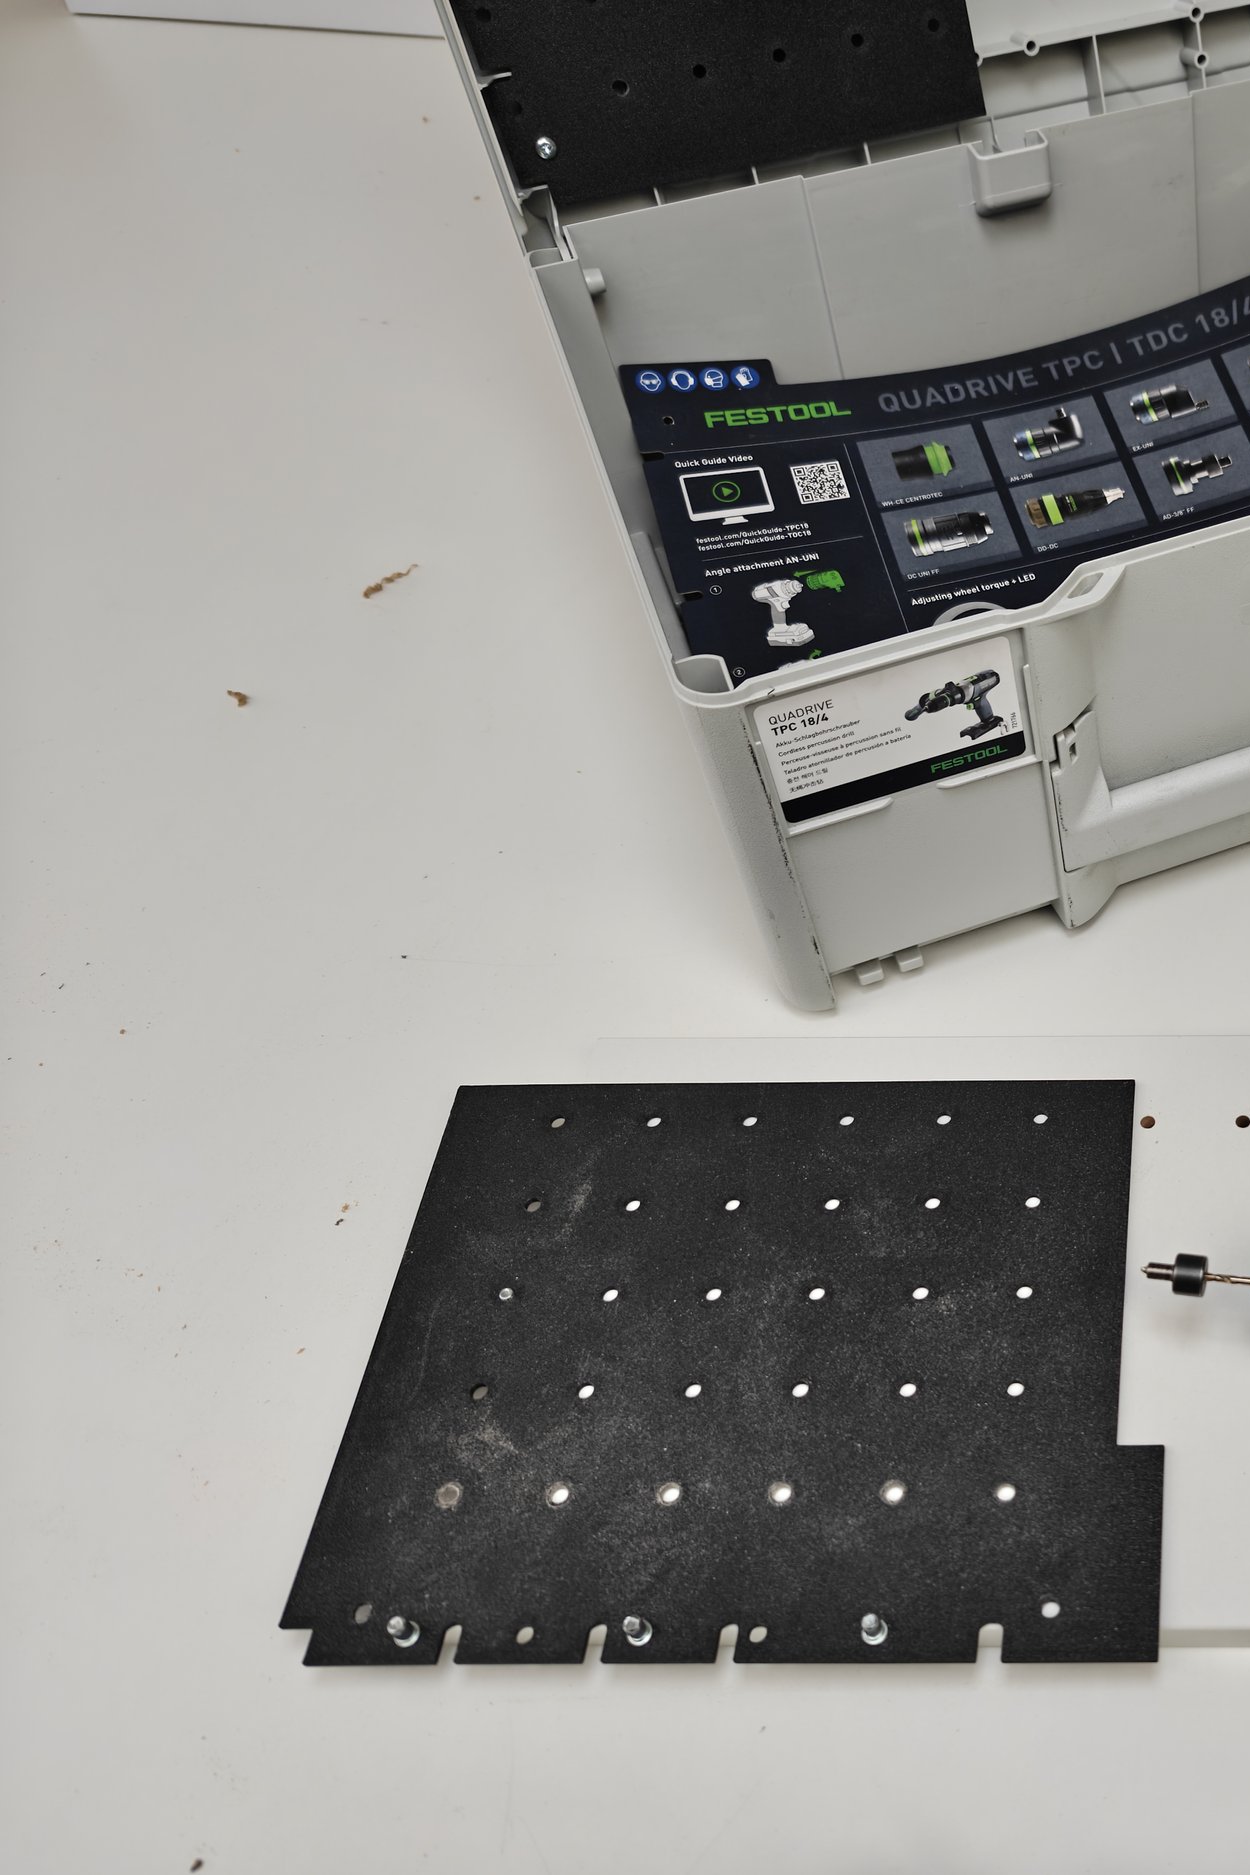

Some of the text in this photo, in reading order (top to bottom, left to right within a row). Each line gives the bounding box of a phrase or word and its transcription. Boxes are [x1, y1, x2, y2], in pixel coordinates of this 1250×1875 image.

[878, 368, 1037, 412] QUADRIVE
[1042, 350, 1104, 380] TPC
[1126, 323, 1188, 356] TDC
[704, 400, 852, 429] FESTOOL
[1132, 441, 1154, 452] EX-UNI
[674, 455, 754, 468] Quick Guide Video
[1009, 472, 1034, 483] AN-UNI
[881, 491, 943, 507] WH-CE CENTROTEC
[696, 523, 809, 544] festool.com/QuickGuide-TPC18
[1036, 542, 1059, 553] DD-DC
[705, 553, 820, 577] Angle attachment AN-UNI
[917, 570, 931, 578] UNI
[911, 592, 952, 606] Adjusting
[953, 587, 977, 597] wheel
[976, 580, 1010, 592] torque
[1017, 573, 1036, 583] LED
[768, 699, 833, 726] QUADRIVE
[771, 713, 829, 736] TPC 18/4
[775, 720, 860, 748] Akku-Schlagbohrschrauber
[778, 730, 855, 758] Cordless percussion drill
[781, 746, 839, 766] Perceuse-visseuse
[845, 734, 879, 749] percussion
[879, 729, 895, 738] sans
[783, 765, 807, 775] Taladro
[808, 754, 844, 768] atornillador
[854, 742, 884, 756] percusión
[889, 734, 912, 744] batería
[930, 745, 1008, 773] FESTOOL
